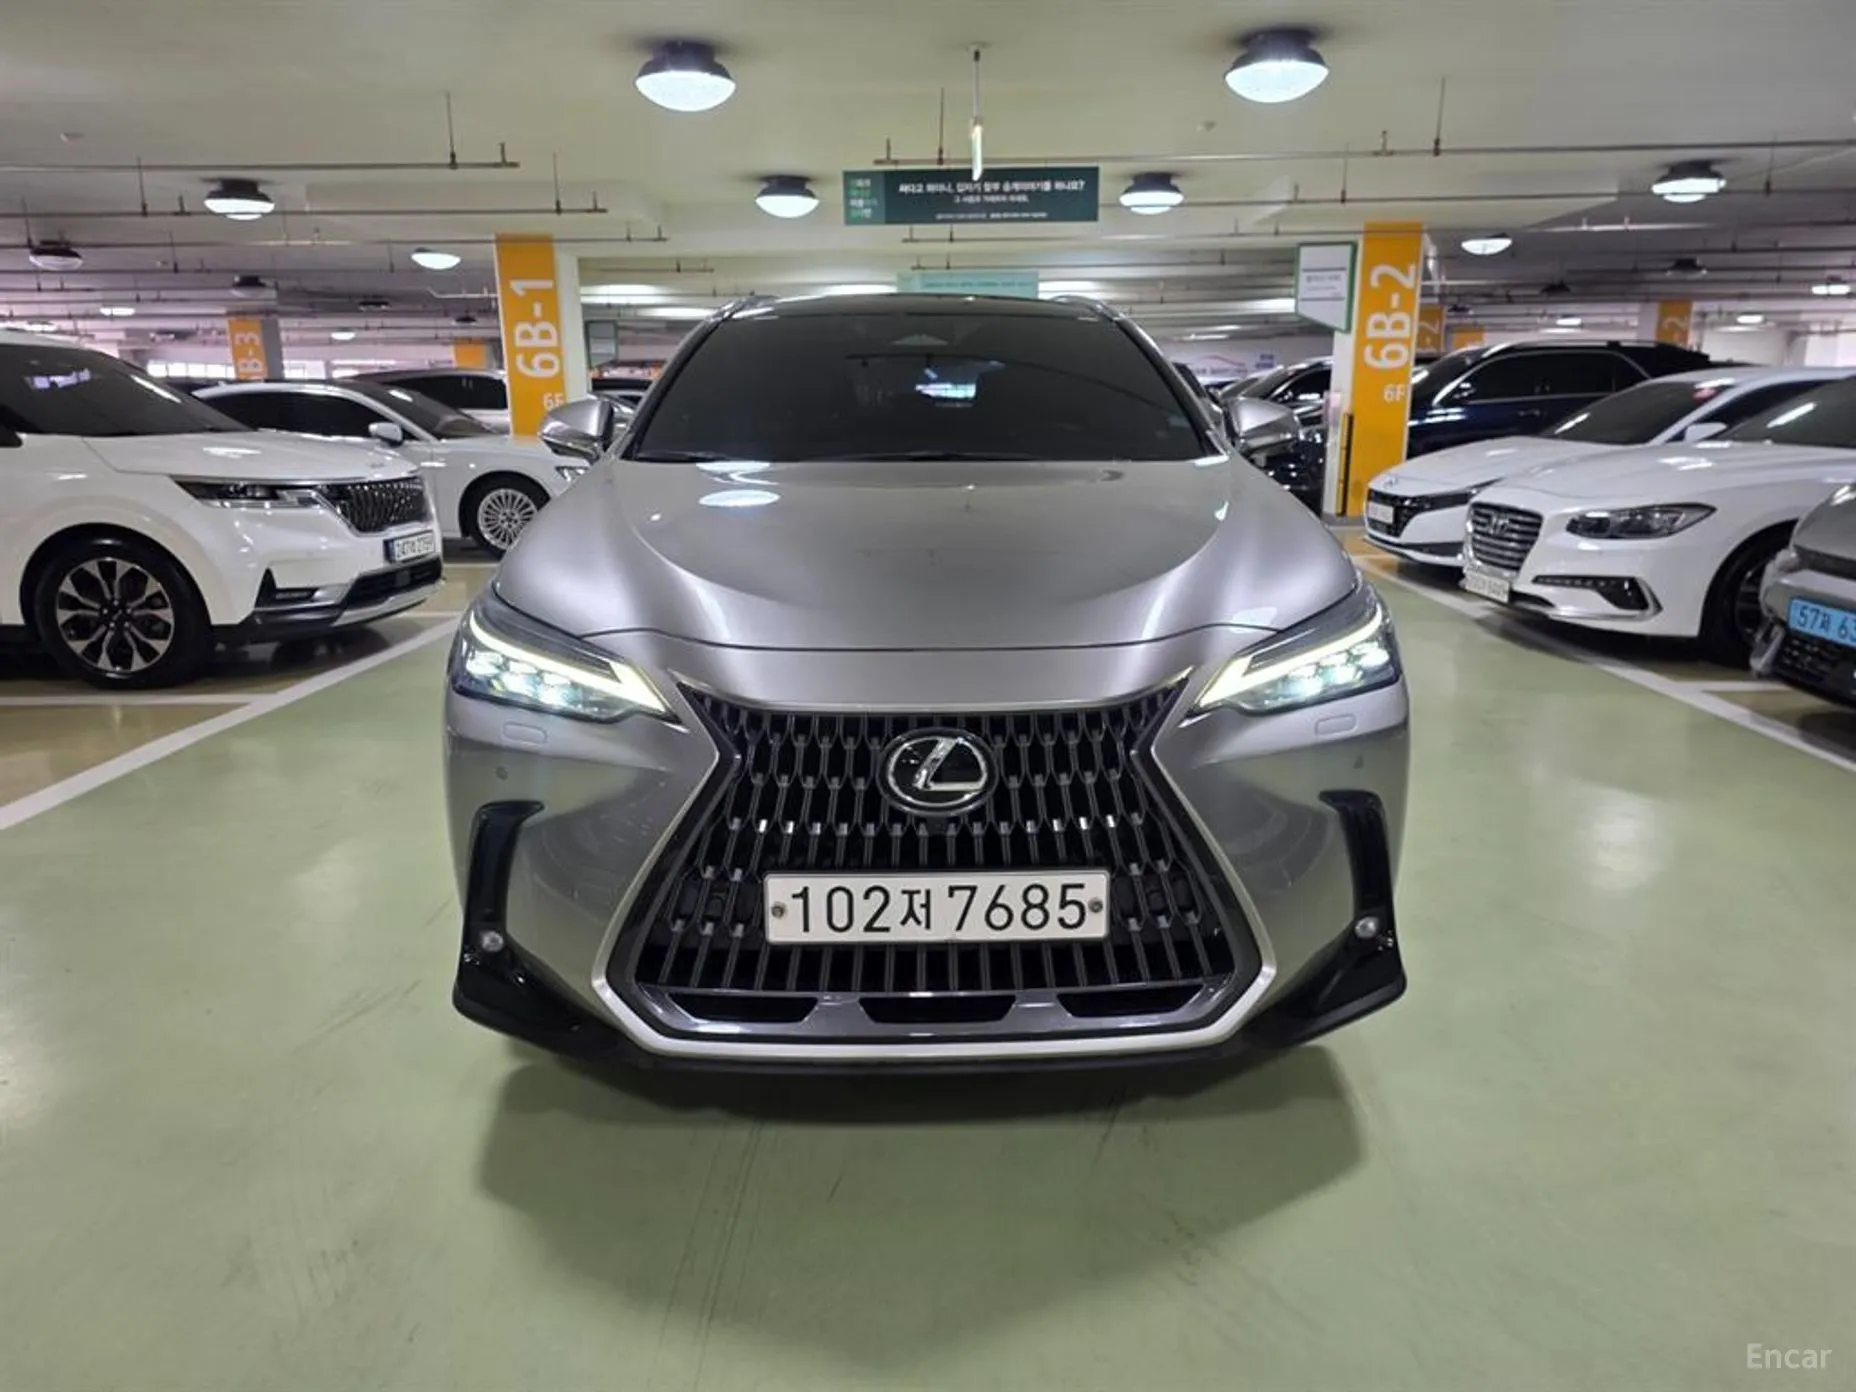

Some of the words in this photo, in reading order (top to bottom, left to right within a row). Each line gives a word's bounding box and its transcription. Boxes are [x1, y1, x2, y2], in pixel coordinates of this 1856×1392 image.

[509, 279, 561, 378] 6B-1
[1363, 262, 1417, 370] 6B-2
[235, 332, 265, 380] B-3
[1384, 384, 1406, 403] 6F
[791, 884, 931, 933] 102저
[947, 883, 1087, 932] 7685
